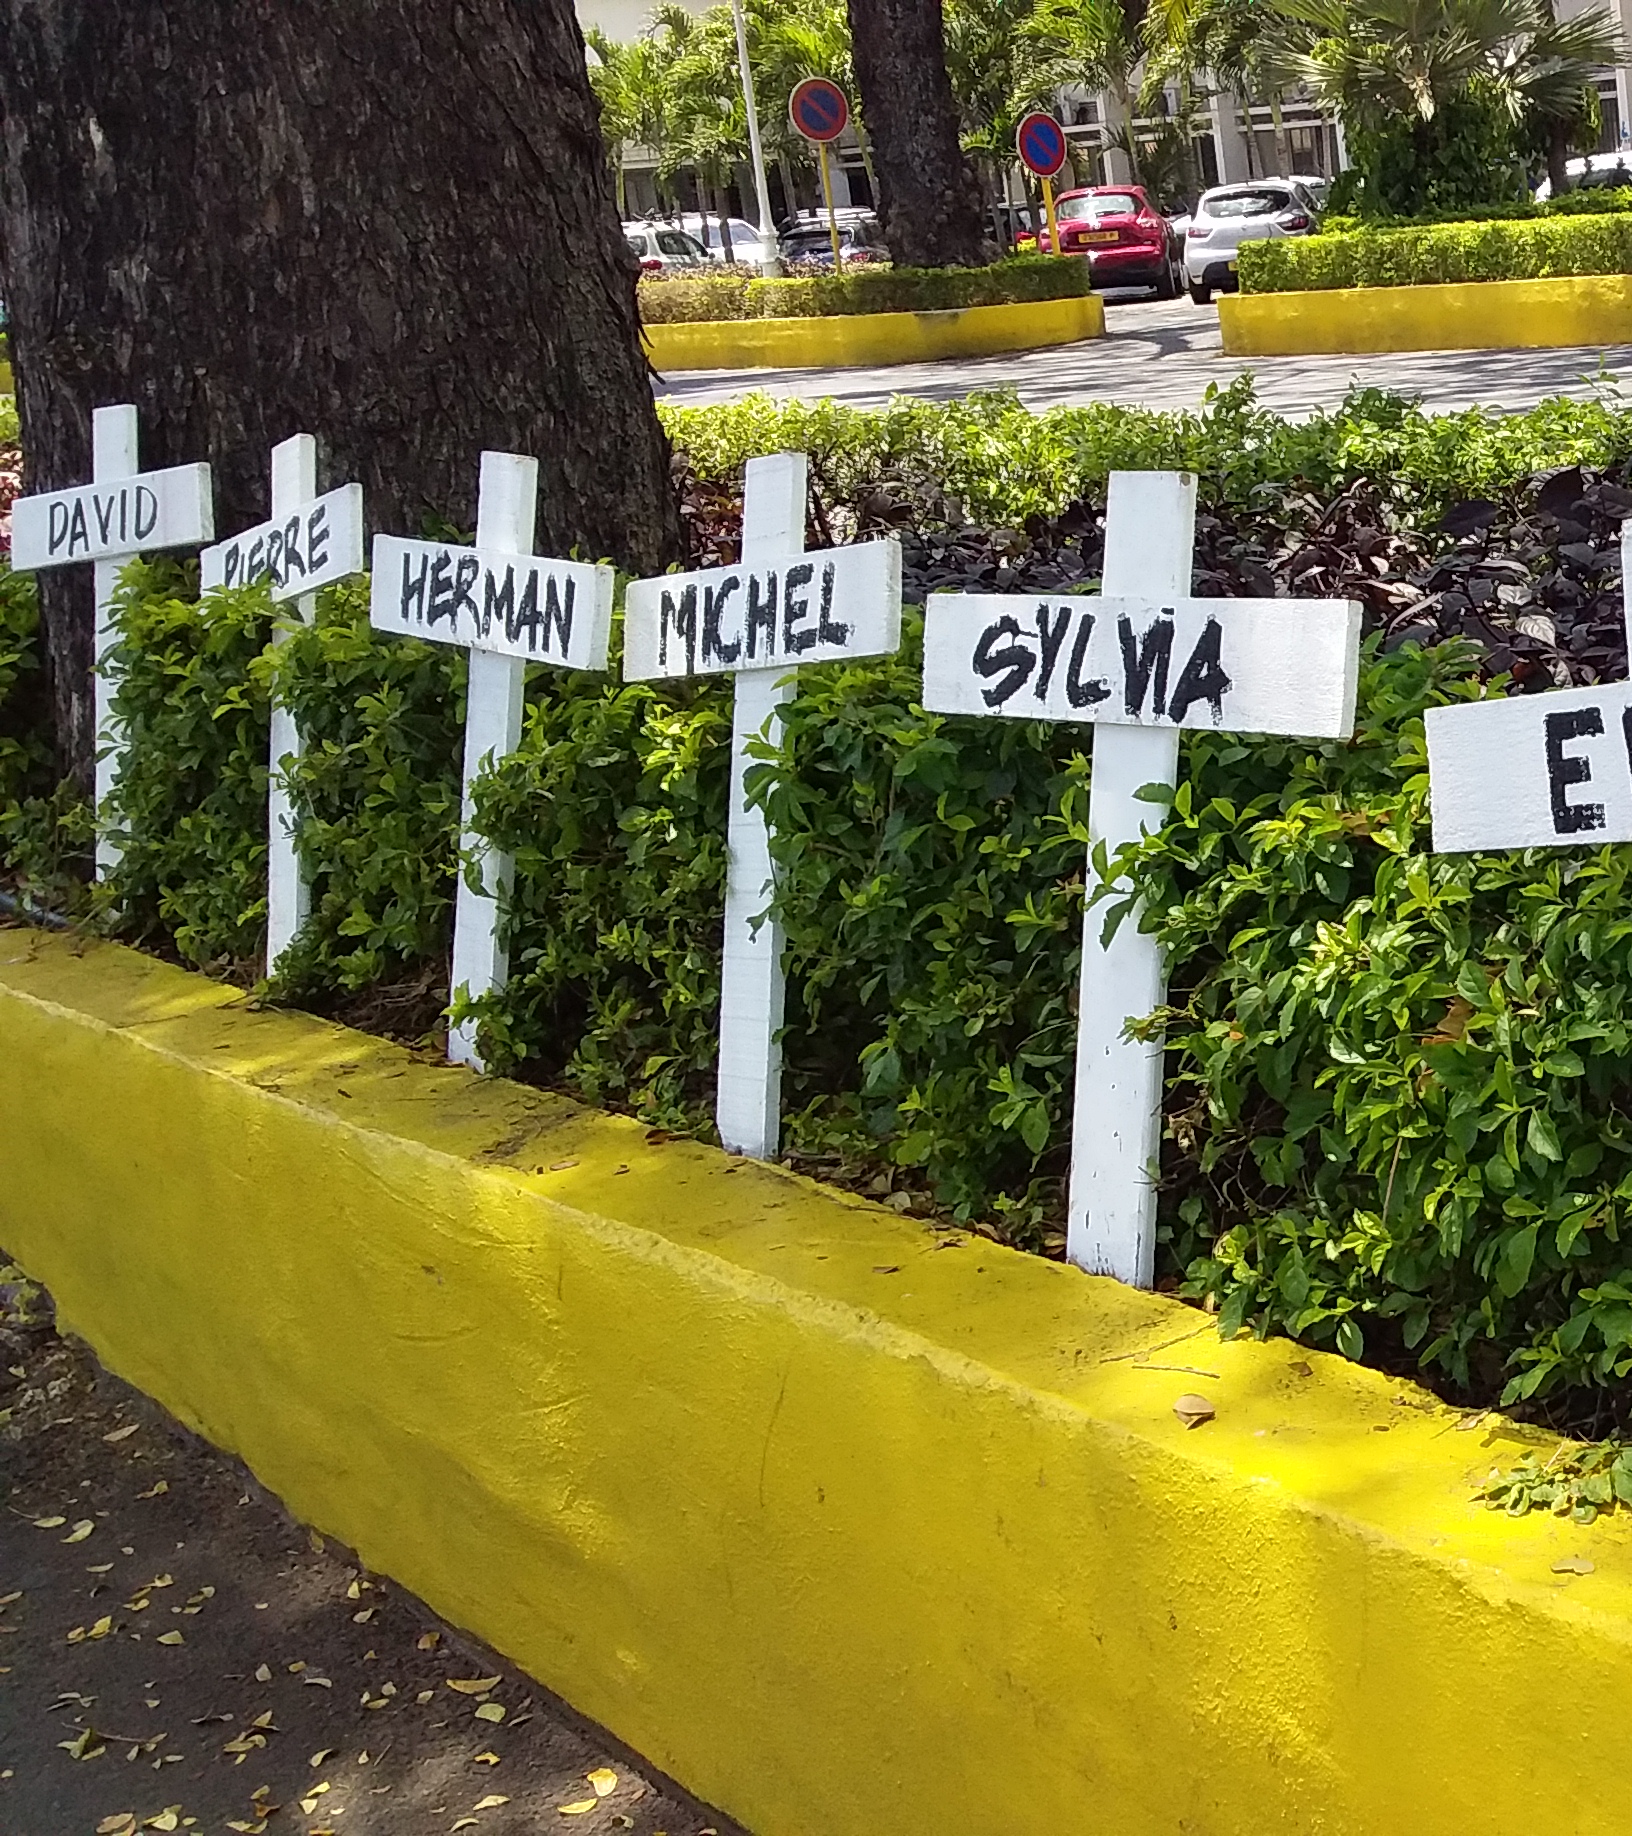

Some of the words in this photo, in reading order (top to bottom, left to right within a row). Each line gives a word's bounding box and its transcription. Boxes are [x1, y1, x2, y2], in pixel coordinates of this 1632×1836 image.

[49, 485, 158, 556] DAVID
[224, 503, 330, 590] PIERRE
[400, 549, 576, 661] HERMAN
[658, 561, 855, 674] MICHEL
[972, 603, 1233, 726] SYLVIA
